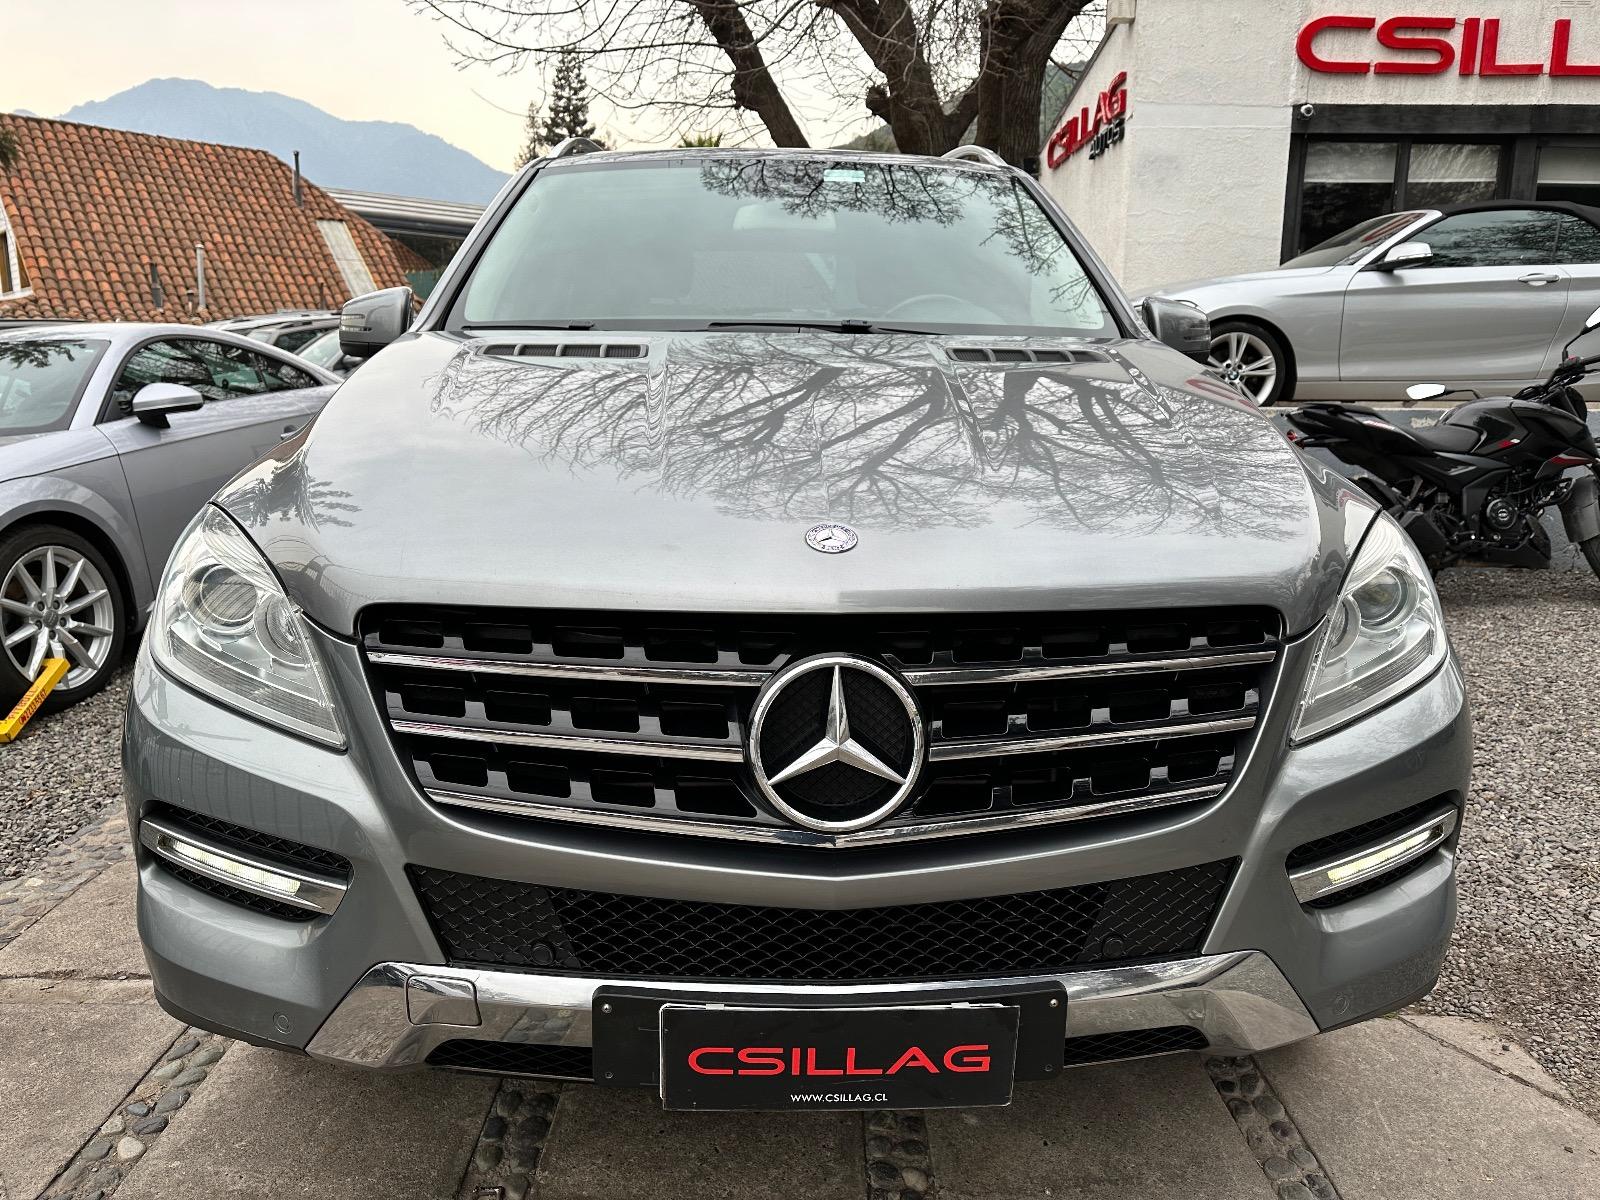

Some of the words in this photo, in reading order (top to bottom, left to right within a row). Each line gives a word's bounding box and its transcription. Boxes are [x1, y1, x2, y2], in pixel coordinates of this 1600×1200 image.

[1296, 16, 1600, 76] CSILL
[687, 1044, 991, 1077] CSILLAG
[790, 1093, 888, 1103] WWW.CSILLAG.CL
